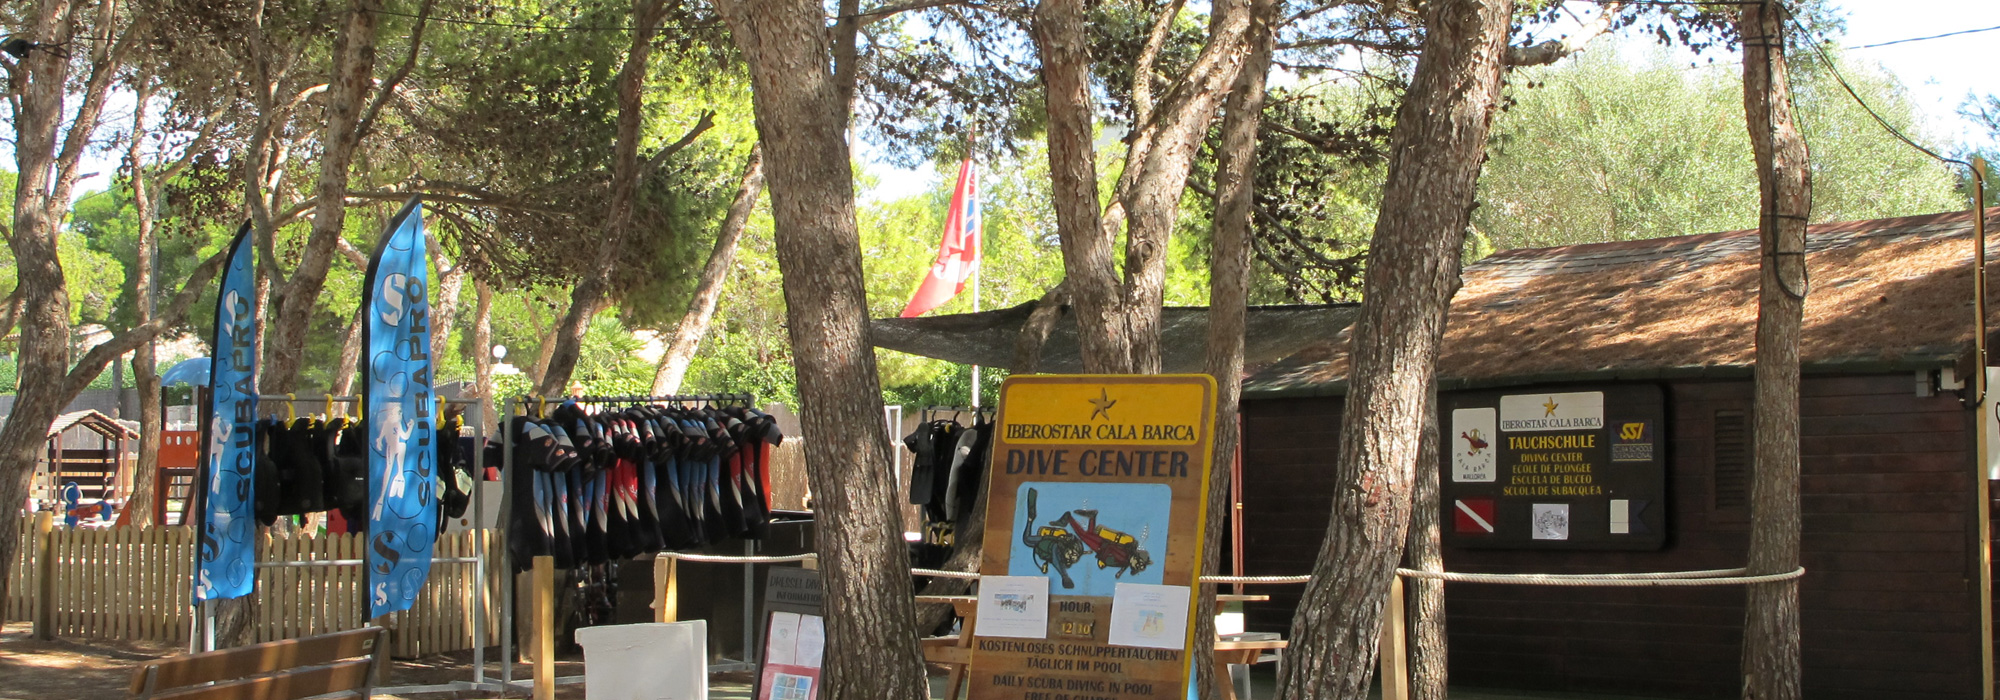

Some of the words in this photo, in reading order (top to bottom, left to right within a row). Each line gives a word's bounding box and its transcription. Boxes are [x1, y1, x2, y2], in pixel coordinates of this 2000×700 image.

[232, 295, 254, 504] SCUBAPRO
[406, 274, 432, 508] SCUBAPRO
[1006, 423, 1092, 440] IBEROSTAR
[1096, 424, 1137, 440] CALA
[1142, 424, 1196, 441] BARCA
[1502, 419, 1548, 430] IBEROSTAR
[1549, 418, 1572, 428] CALA
[1573, 417, 1602, 427] BARCA
[1619, 422, 1645, 440] SSI
[1508, 434, 1596, 450] TAUCHSCHULE
[1005, 448, 1069, 476] DIVE
[1078, 450, 1190, 478] CENTER
[1520, 453, 1549, 463] DIVING
[1551, 452, 1583, 462] CENTER
[1512, 464, 1539, 474] ECOLE
[1540, 464, 1551, 473] DE
[1554, 463, 1592, 473] PLONGEE
[1511, 475, 1548, 485] ESCUELA
[1550, 475, 1562, 484] DE
[1563, 474, 1592, 484] BUCEO
[1503, 486, 1536, 496] SCUOLA
[1538, 486, 1550, 496] DE
[1551, 485, 1602, 497] SUBACQUEA
[1059, 601, 1095, 613] HOUR:
[1061, 622, 1073, 634] 12
[978, 639, 1054, 655] KOSTENLOSES
[1058, 643, 1179, 662] SCHNUPPERTAUCHEN
[1026, 654, 1073, 671] TÄGLICH
[1076, 659, 1090, 671] IM
[1093, 660, 1124, 673] POOL
[993, 674, 1024, 687] DAILY
[1027, 676, 1064, 689] SCUBA
[1066, 679, 1105, 693] DIVING
[1108, 681, 1121, 694] IN
[1123, 682, 1155, 695] POOL
